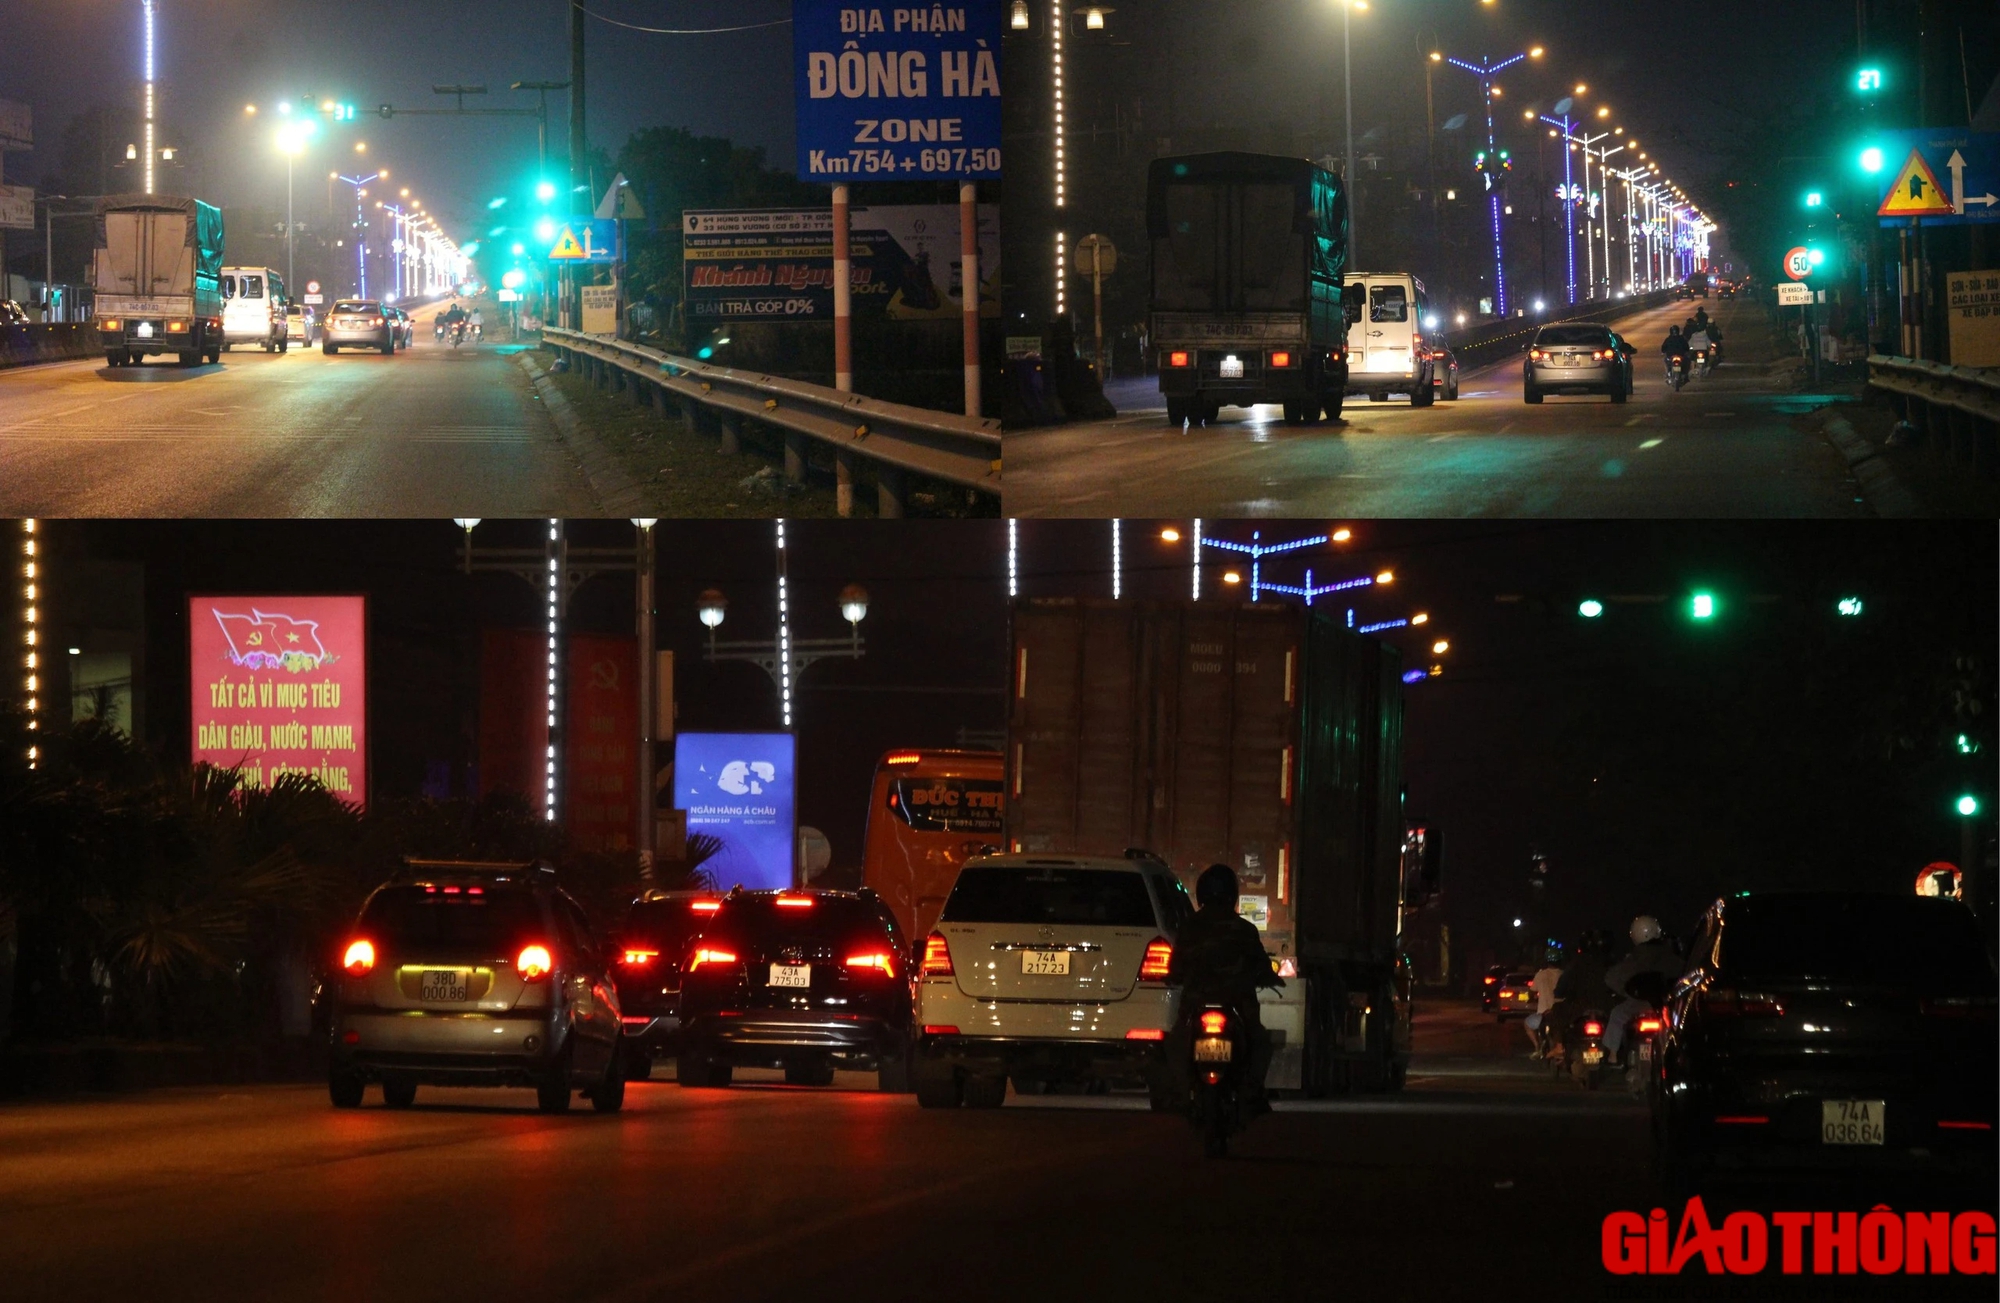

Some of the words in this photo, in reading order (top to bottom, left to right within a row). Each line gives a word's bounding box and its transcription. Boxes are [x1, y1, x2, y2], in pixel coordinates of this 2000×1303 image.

[840, 10, 885, 38] ĐỊA
[894, 3, 966, 38] PHẬN
[807, 41, 928, 99] ĐÔNG
[941, 38, 1001, 98] HÀ
[1859, 70, 1880, 89] 27
[854, 118, 963, 142] ZONE
[1793, 257, 1808, 271] 50
[784, 299, 814, 315] 0%
[210, 675, 234, 708] TẤT
[238, 675, 256, 708] CẢ
[260, 678, 273, 708] VÌ
[277, 683, 307, 713] MỤC
[311, 678, 341, 708] TIÊU
[199, 720, 227, 750] DÂN
[231, 720, 266, 752] GIÀU,
[270, 720, 307, 750] NƯỚC
[311, 725, 356, 755] MẠNH,
[690, 804, 716, 815] NGÂN
[717, 804, 743, 815] HÀNG
[743, 805, 751, 815] Á
[751, 805, 776, 816] CHÂU
[1037, 952, 1056, 962] 74A
[781, 967, 799, 976] 43A
[1027, 963, 1065, 974] 217.23
[433, 972, 456, 985] 38D
[774, 976, 806, 986] 775.03
[1838, 1101, 1871, 1122] 74A
[1825, 1123, 1882, 1143] 036.64
